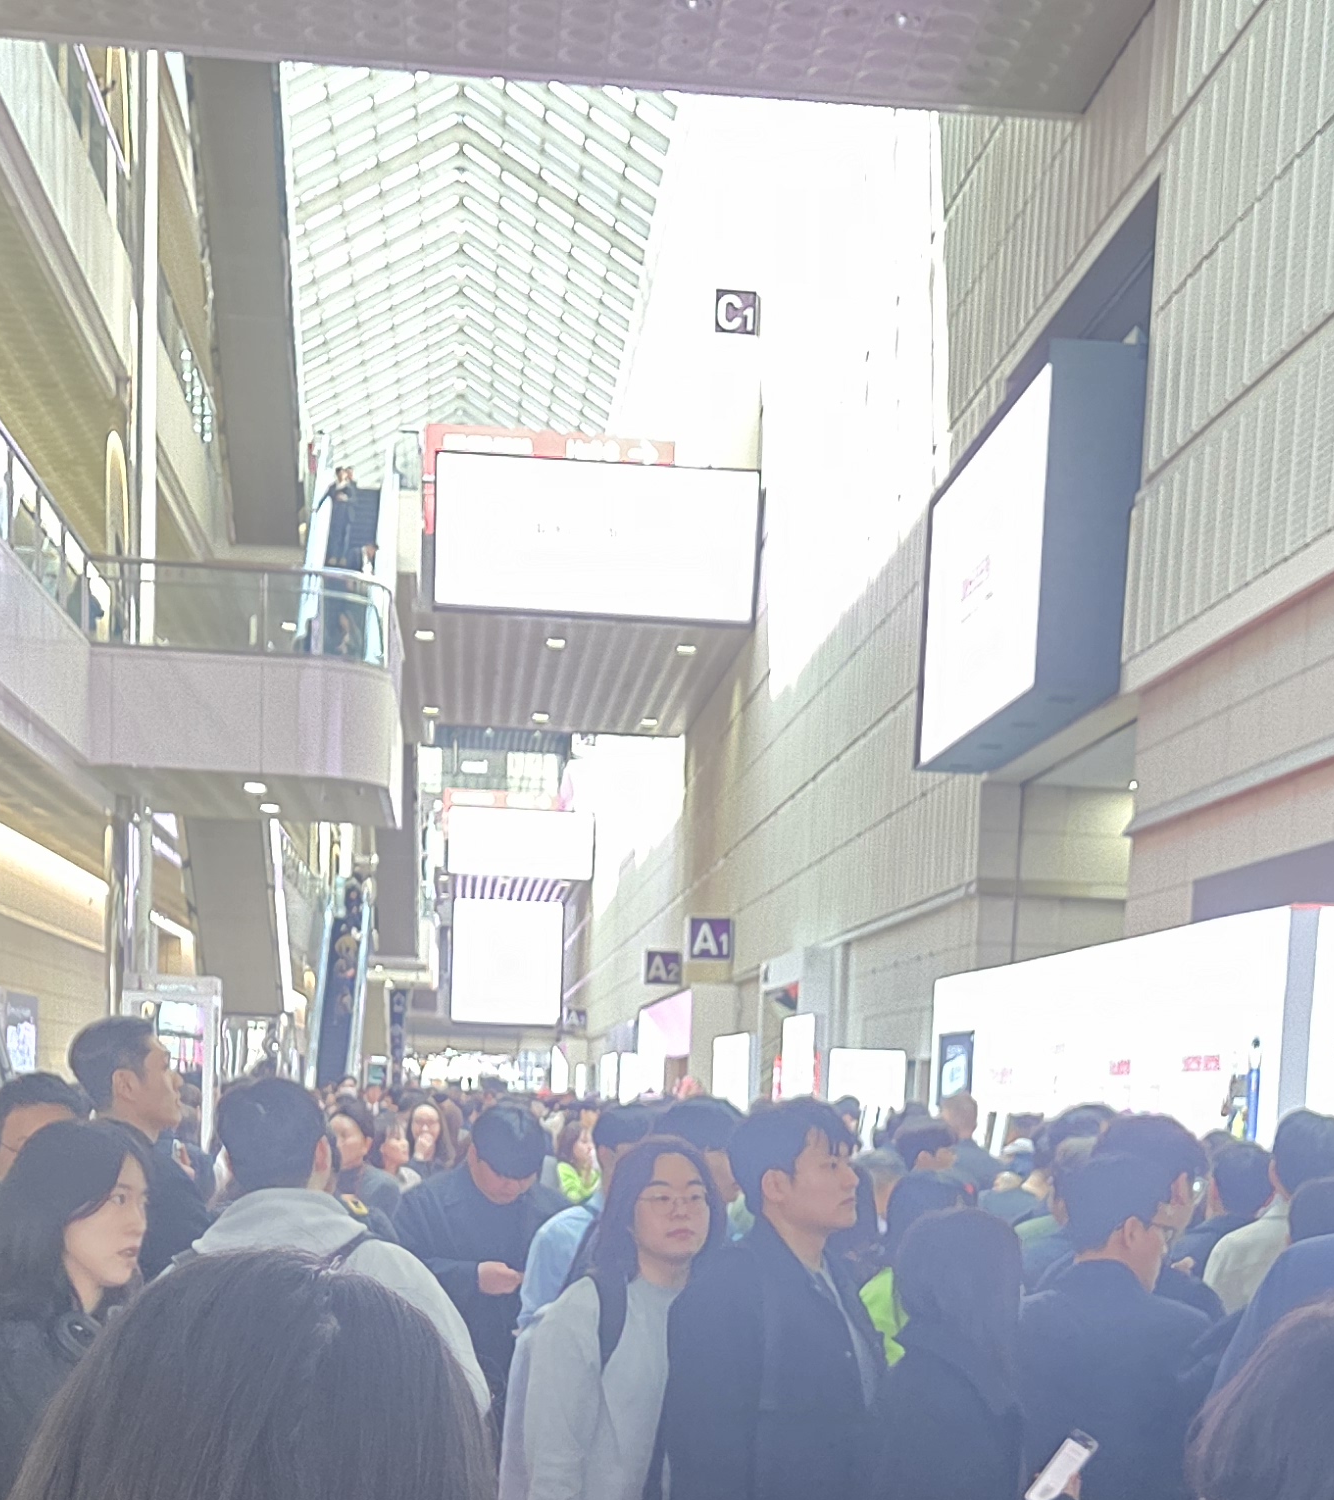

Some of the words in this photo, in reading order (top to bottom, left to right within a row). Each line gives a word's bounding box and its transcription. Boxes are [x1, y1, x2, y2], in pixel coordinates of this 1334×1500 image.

[717, 293, 755, 332] C1
[692, 922, 729, 956] A1
[647, 954, 681, 981] A2
